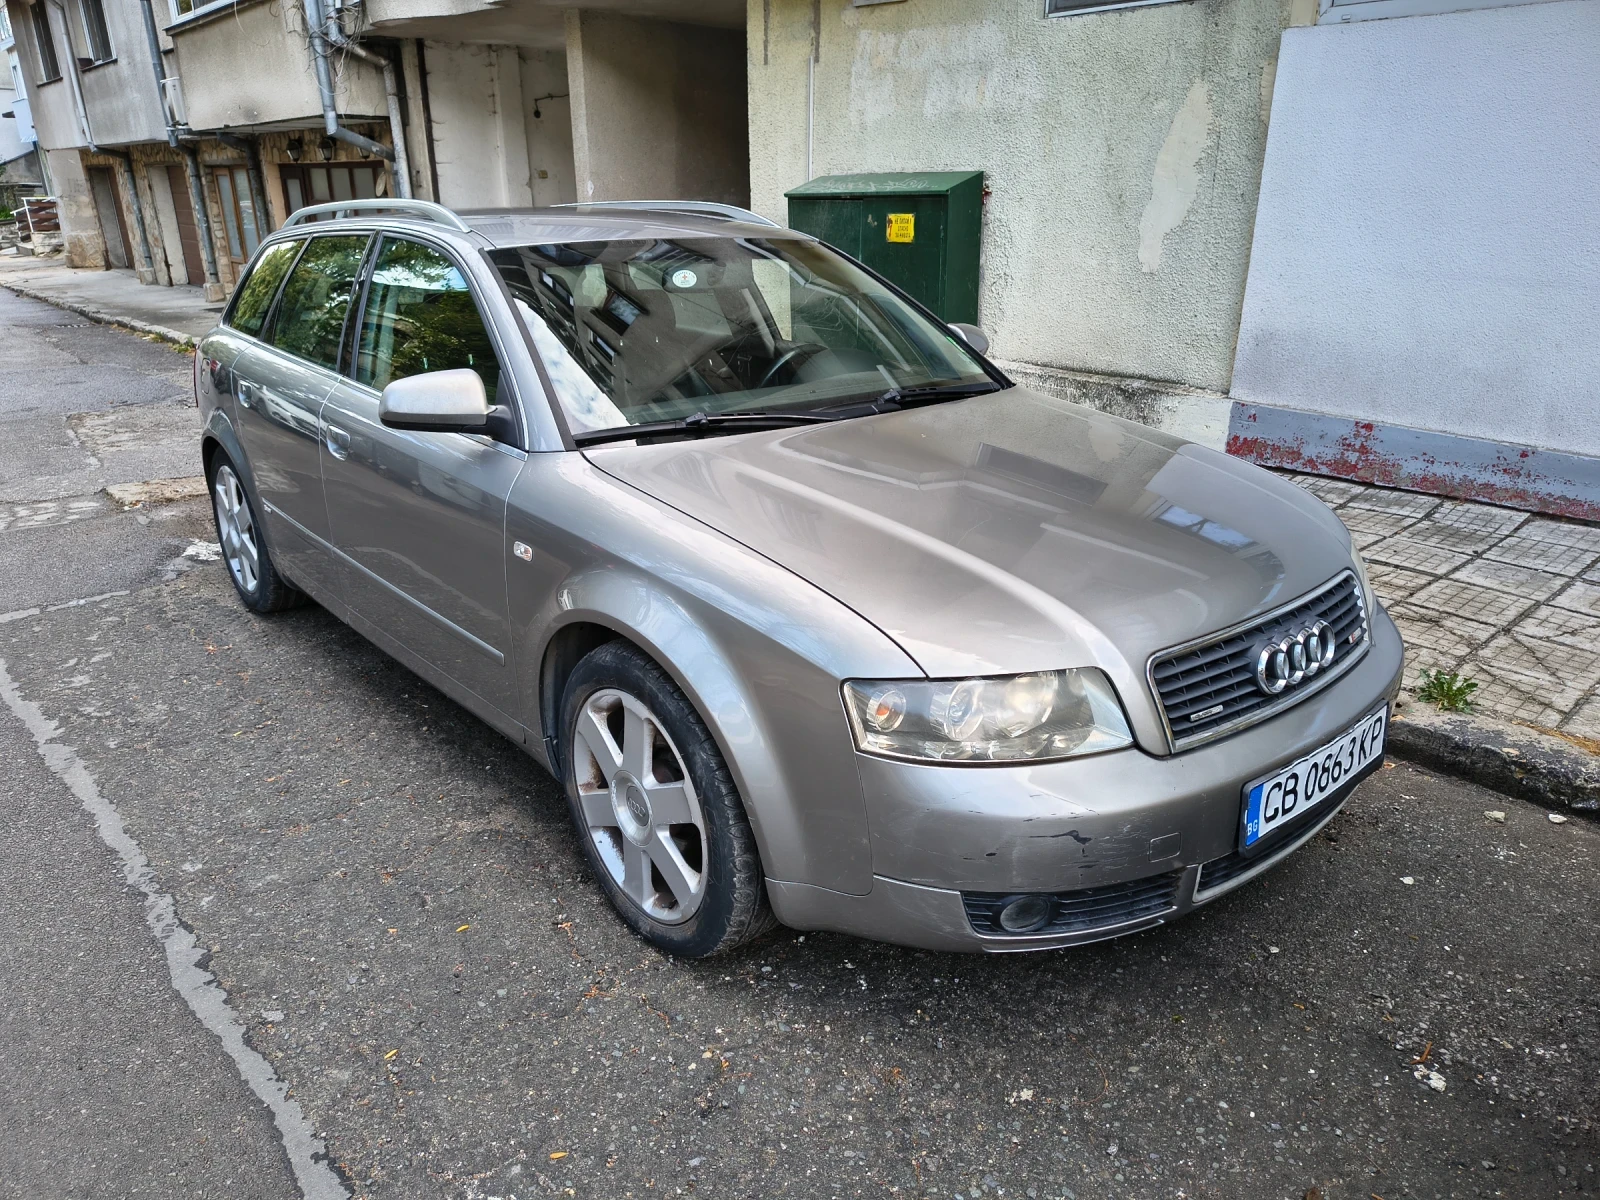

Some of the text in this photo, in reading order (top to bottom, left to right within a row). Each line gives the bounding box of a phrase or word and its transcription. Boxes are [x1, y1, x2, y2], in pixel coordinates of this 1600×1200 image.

[1264, 715, 1383, 824] CB 0863 KP
[1247, 819, 1258, 836] BG
